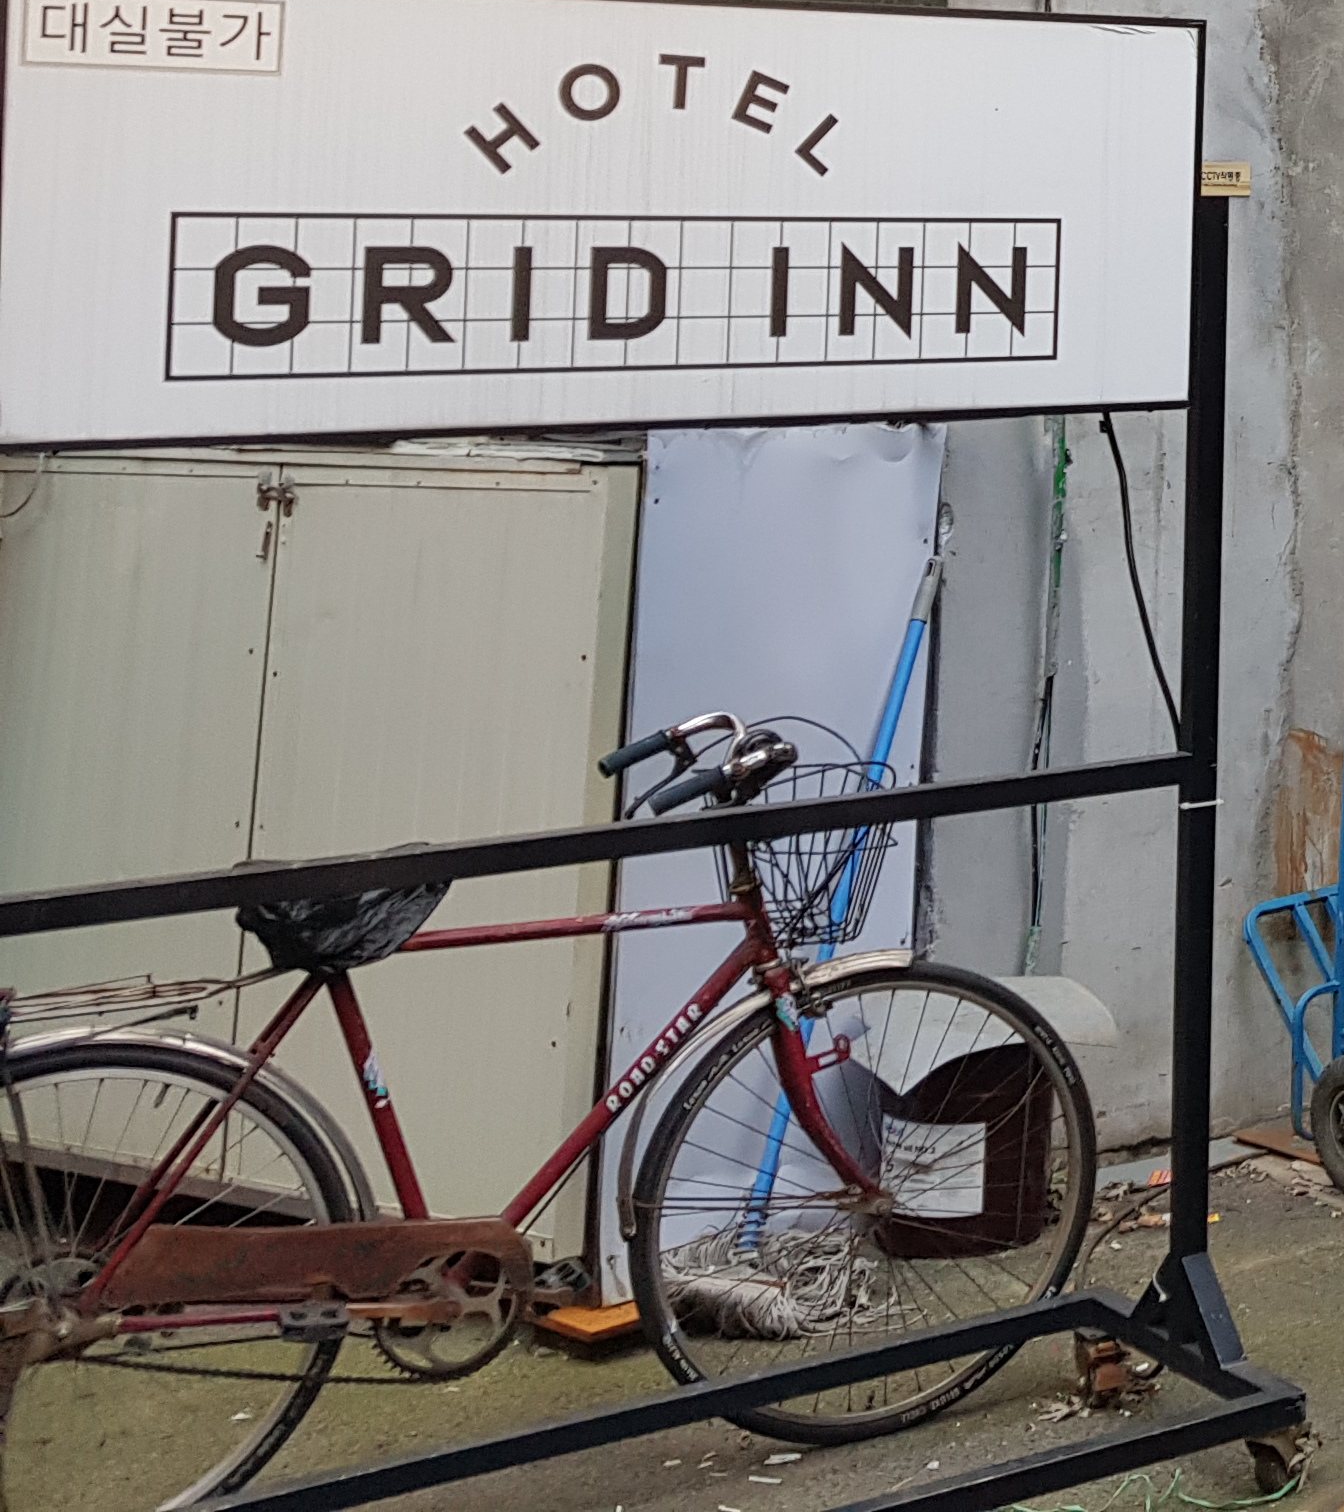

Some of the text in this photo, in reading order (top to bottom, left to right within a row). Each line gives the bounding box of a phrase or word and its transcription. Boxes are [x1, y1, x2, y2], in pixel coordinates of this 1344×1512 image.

[40, 2, 272, 61] 대실불가
[464, 53, 841, 176] HOTEL
[211, 240, 1027, 348] GRID INN
[607, 1002, 703, 1113] ROAD STAR
